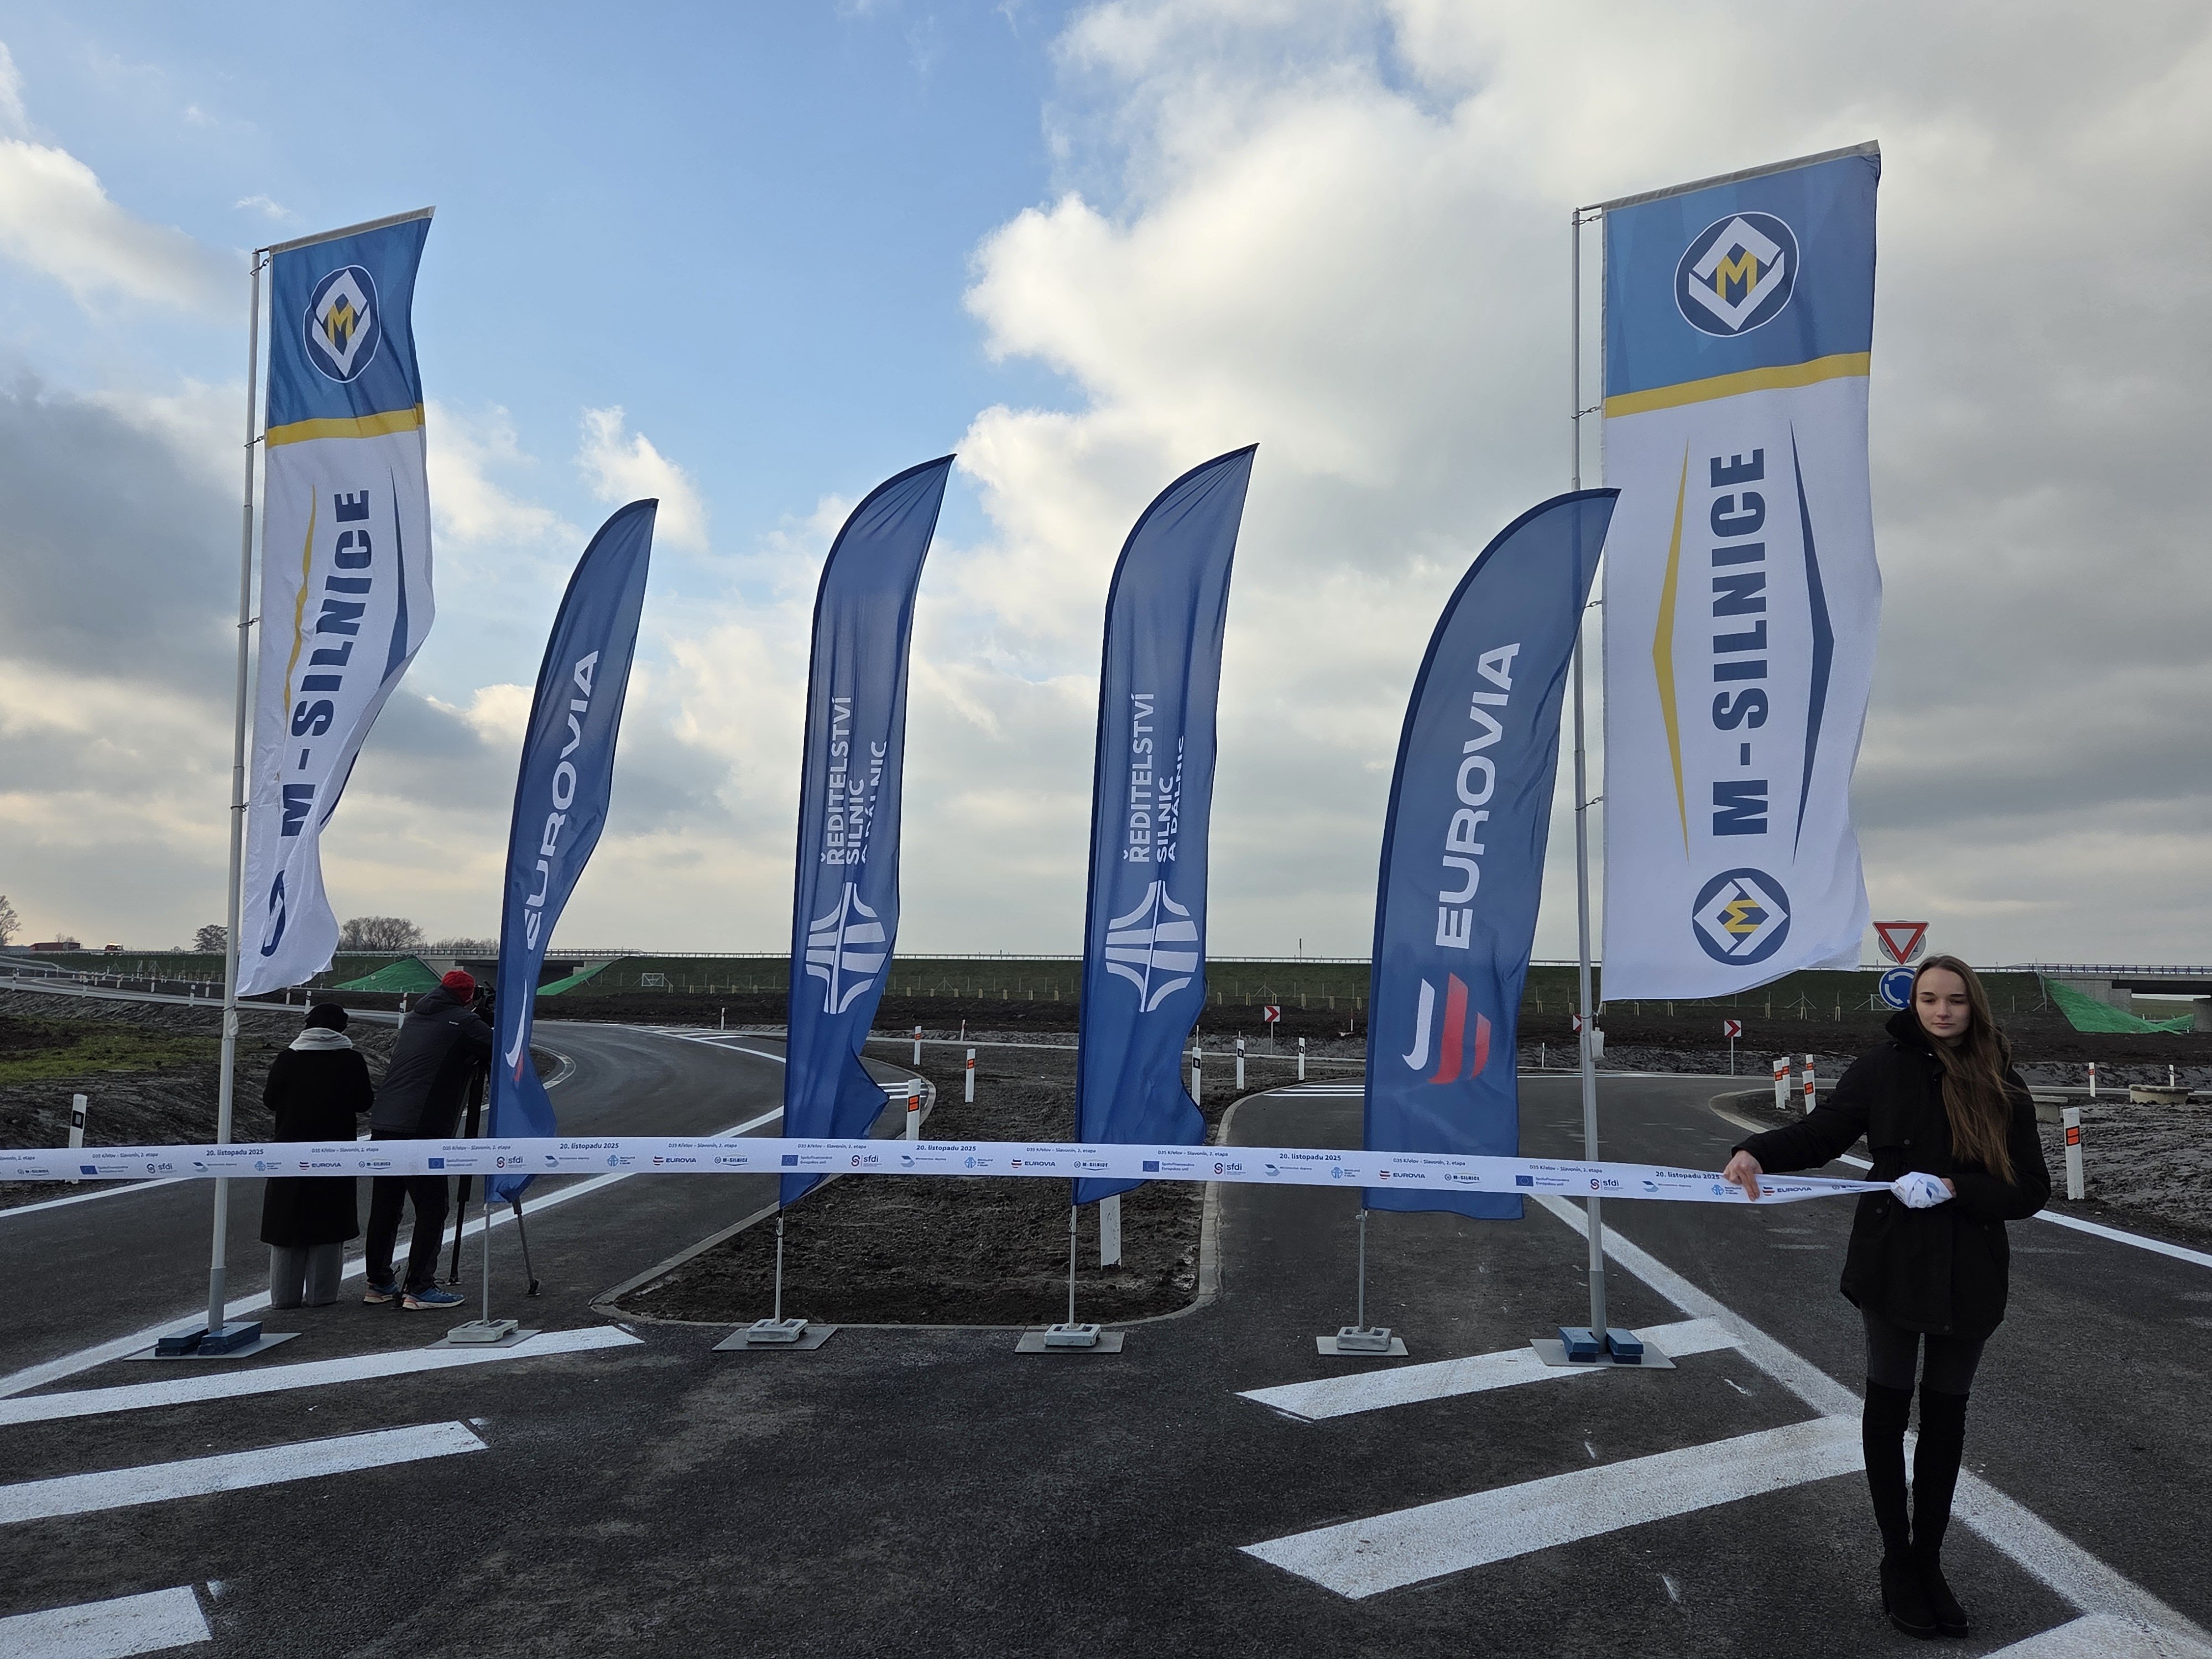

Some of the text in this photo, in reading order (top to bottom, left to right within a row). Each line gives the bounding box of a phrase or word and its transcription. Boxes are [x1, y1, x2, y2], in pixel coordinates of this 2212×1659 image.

[523, 650, 599, 951] EUROVIA
[820, 696, 852, 865] ŘEDITELSTVÍ
[1123, 693, 1154, 862] ŘEDITELSTVÍ
[1157, 776, 1173, 863] SILNIC
[1435, 642, 1521, 950] EUROVIA
[846, 778, 864, 865] SILNIC
[1168, 842, 1176, 862] A
[508, 1156, 523, 1164] sfdi
[863, 1155, 879, 1163] sfdi
